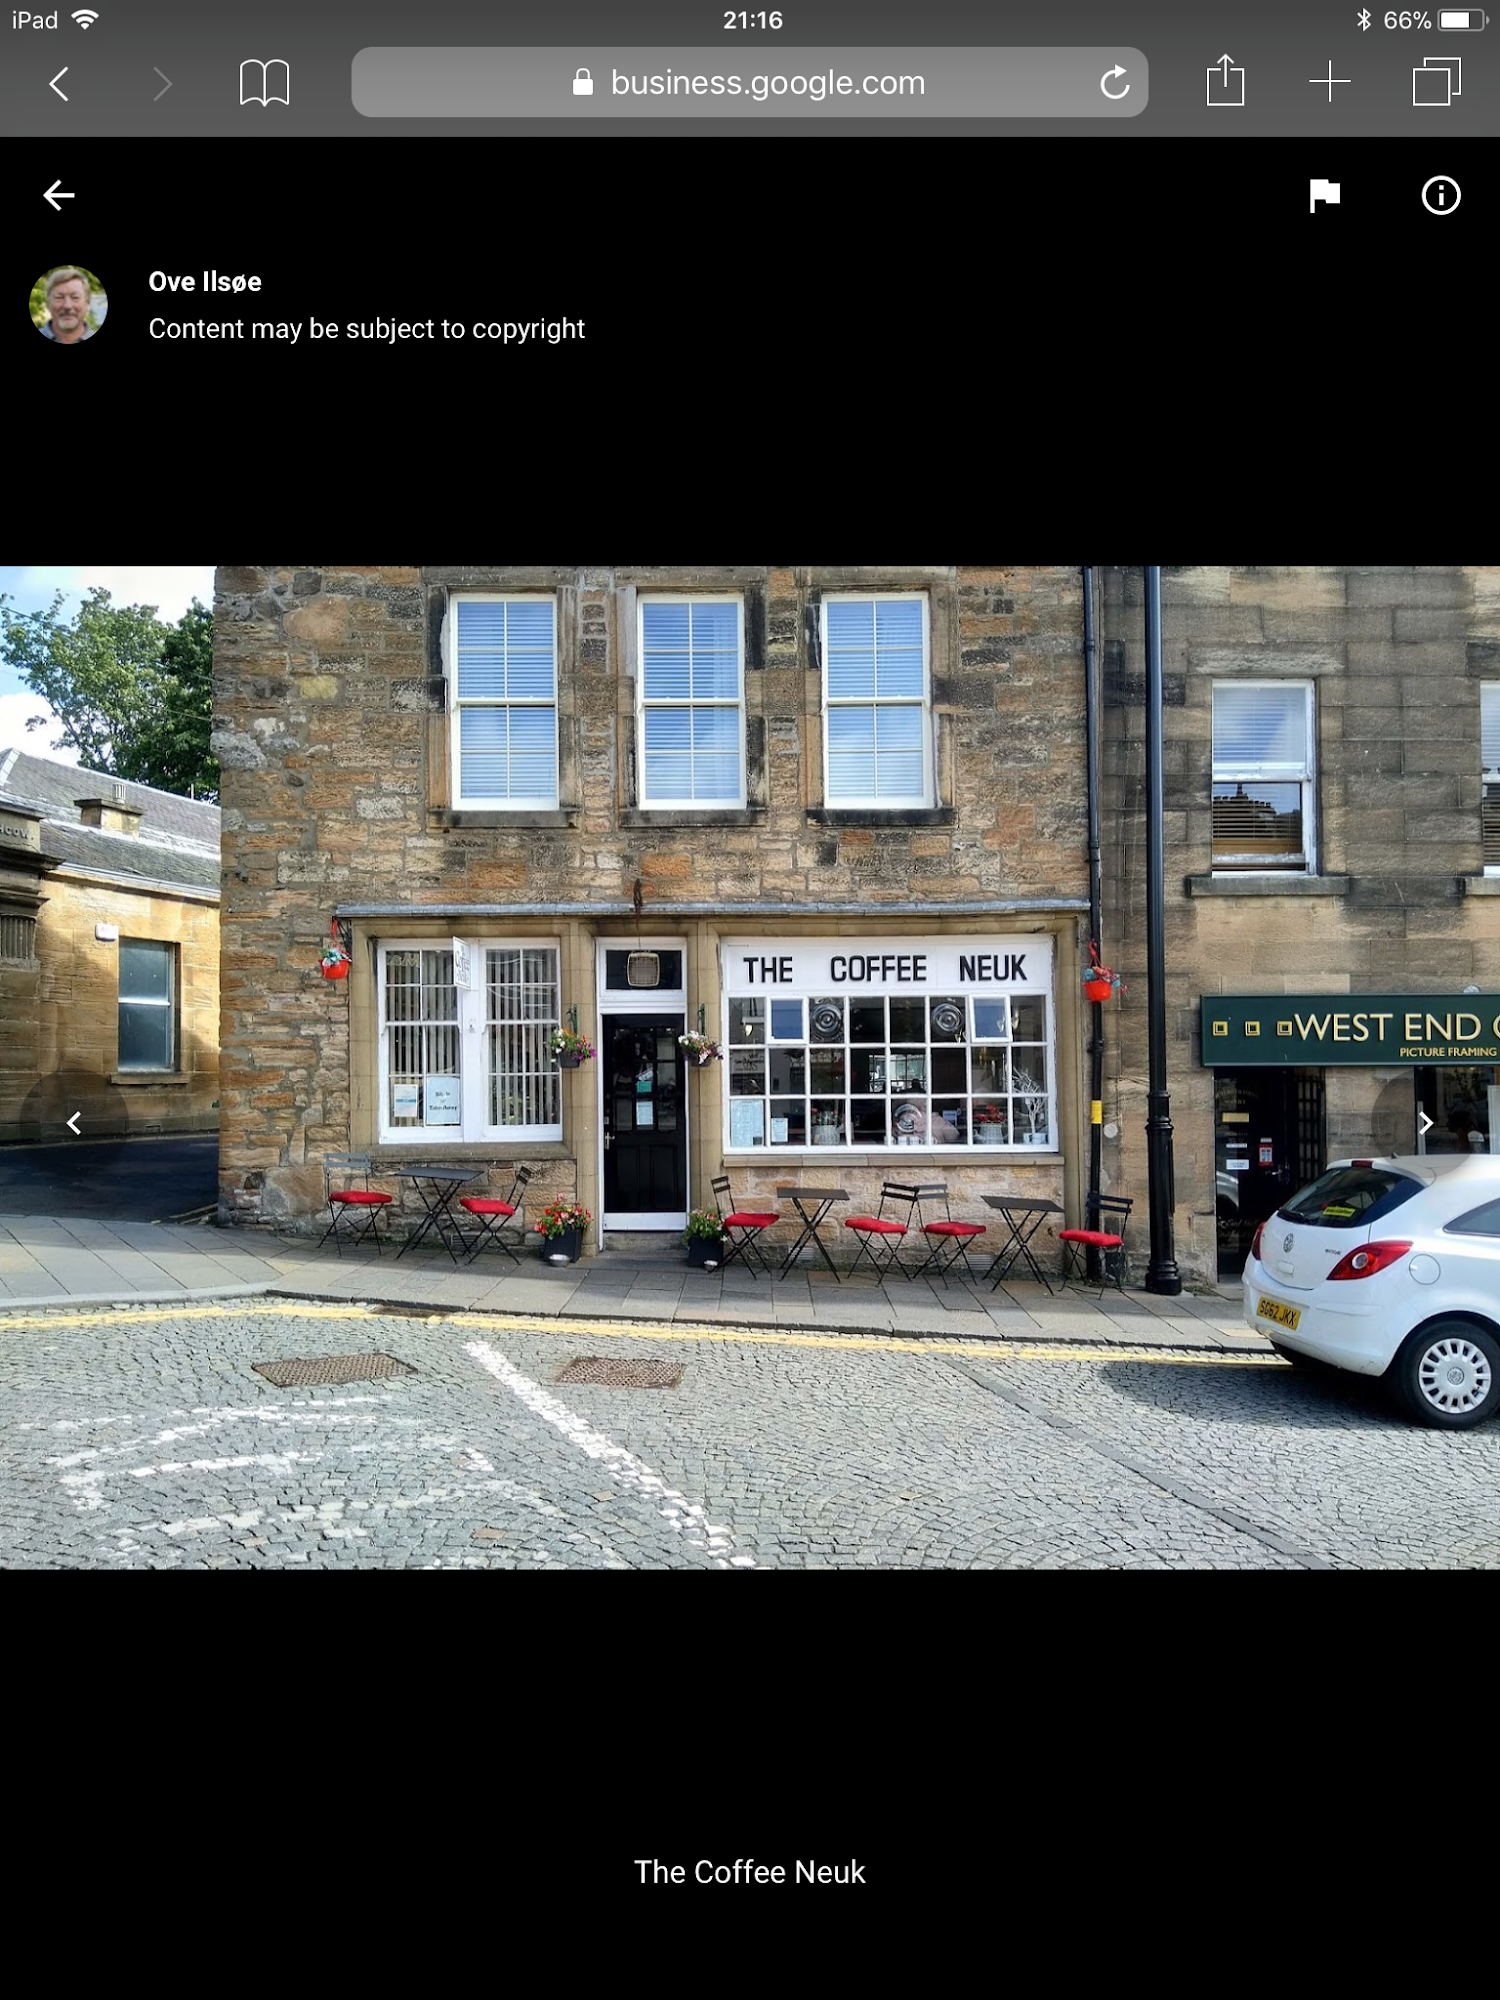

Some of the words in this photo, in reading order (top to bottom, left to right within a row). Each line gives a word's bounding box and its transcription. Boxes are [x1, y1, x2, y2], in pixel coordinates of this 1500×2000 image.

[743, 956, 793, 983] THE
[830, 954, 928, 982] COFFEE
[959, 954, 1028, 982] NEUK
[1294, 1013, 1394, 1041] WEST
[1404, 1013, 1482, 1041] END
[1399, 1047, 1446, 1058] PICTURE
[1447, 1047, 1498, 1058] FRAMING
[1259, 1299, 1280, 1320] SG62
[1279, 1307, 1298, 1327] JKX
